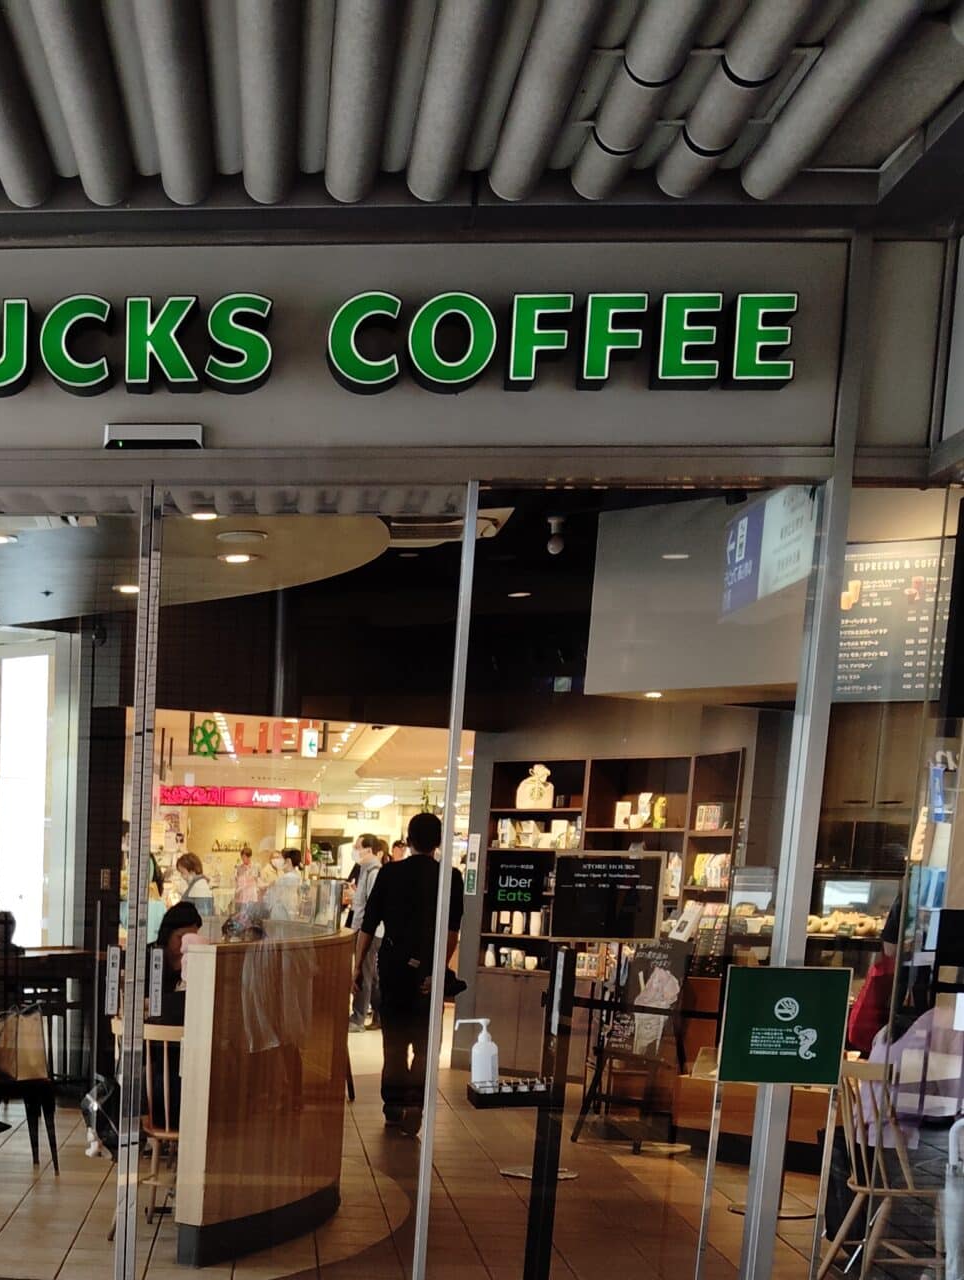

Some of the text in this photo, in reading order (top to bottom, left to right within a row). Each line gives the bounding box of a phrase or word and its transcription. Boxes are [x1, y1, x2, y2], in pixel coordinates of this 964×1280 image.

[327, 290, 799, 393] COFFEE
[914, 557, 947, 570] COFFE
[498, 875, 533, 888] Uber
[497, 889, 532, 902] Eats
